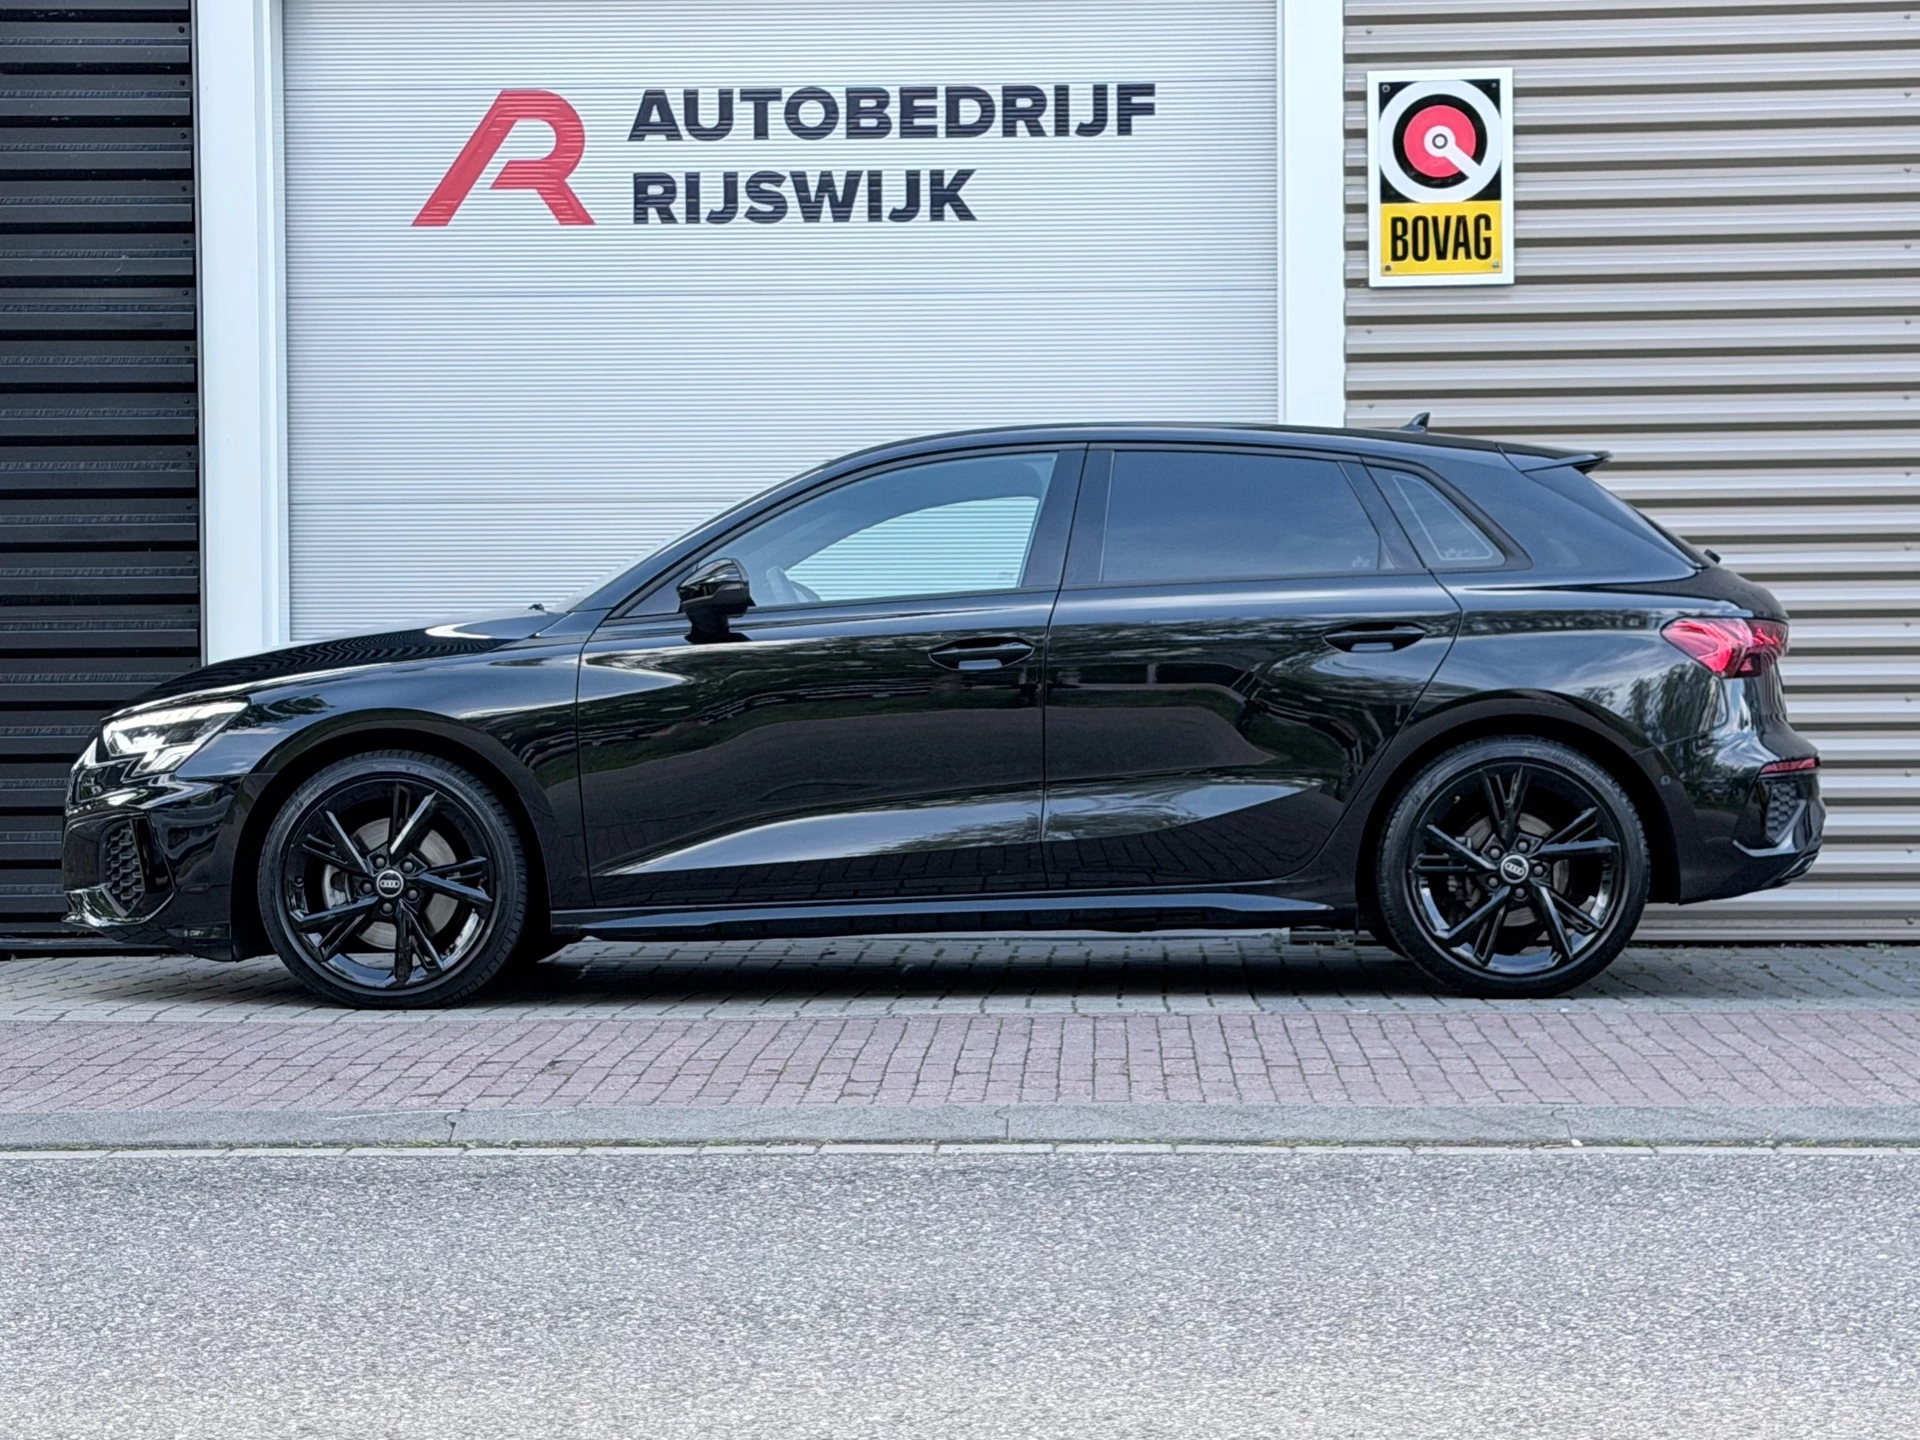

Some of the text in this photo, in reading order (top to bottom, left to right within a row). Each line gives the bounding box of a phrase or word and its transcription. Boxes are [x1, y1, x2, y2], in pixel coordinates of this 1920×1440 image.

[627, 84, 1156, 141] AUTOBEDRIJF
[633, 169, 979, 225] RIJSWIJK
[1390, 213, 1492, 262] BOVAG
